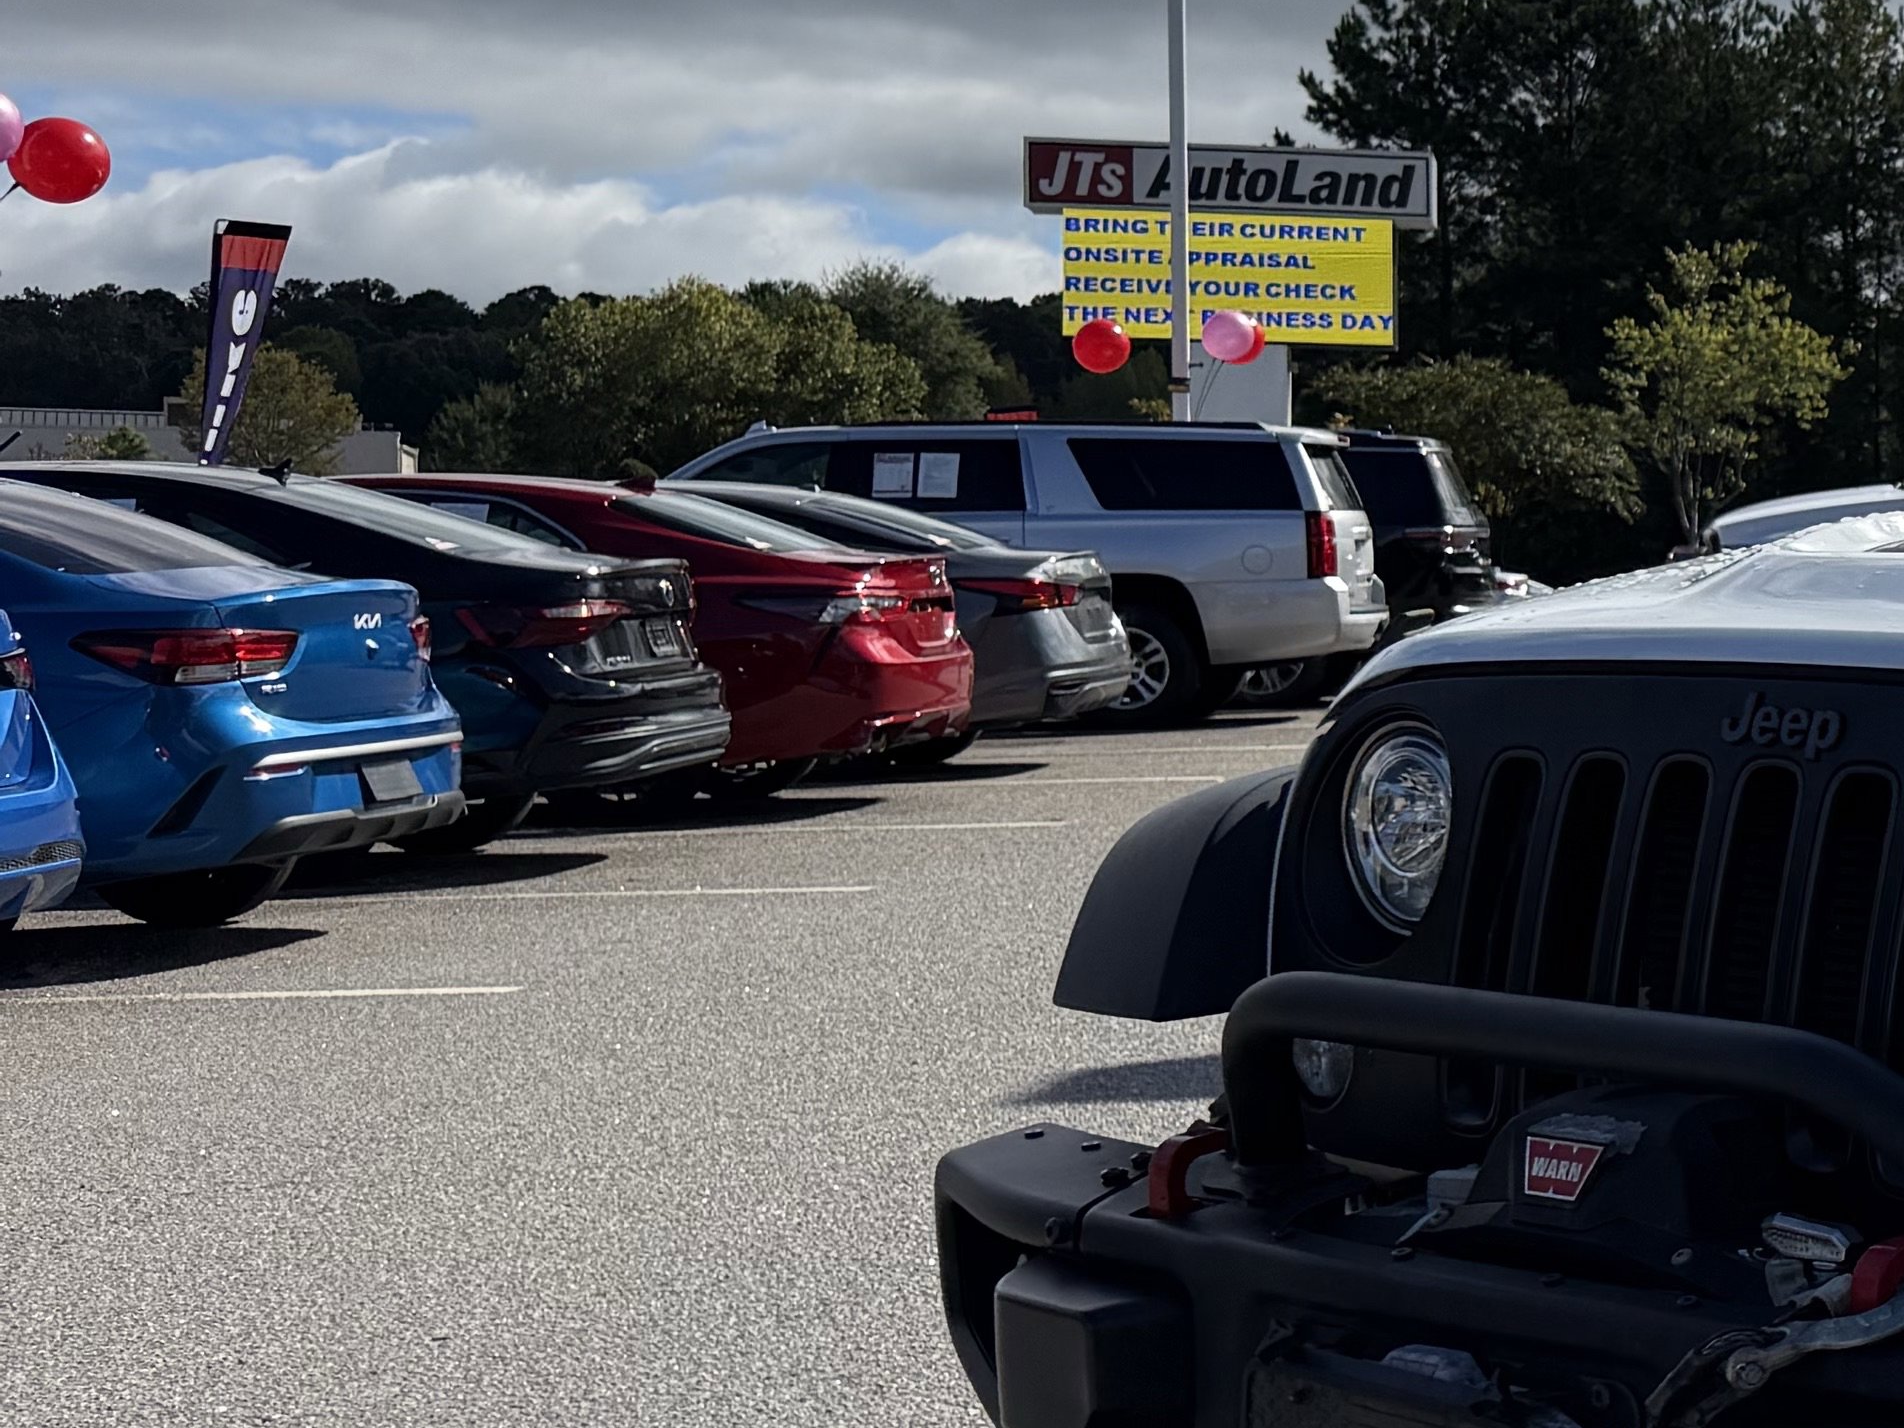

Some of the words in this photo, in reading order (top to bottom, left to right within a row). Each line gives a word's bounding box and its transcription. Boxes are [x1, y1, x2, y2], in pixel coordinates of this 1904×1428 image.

[1065, 217, 1149, 234] BRING
[1155, 220, 1235, 237] TEIR
[1240, 223, 1367, 242] CURRENT
[1064, 246, 1164, 265] ONSITE
[1168, 250, 1316, 270] PPRAISAL
[1189, 280, 1260, 298] YOUR
[1265, 283, 1357, 301] CHECK
[1065, 305, 1118, 323] THE
[1125, 307, 1195, 325] NEX
[1202, 310, 1333, 328] INESS
[1341, 313, 1393, 331] DAY
[1721, 691, 1841, 759] Jeep
[1531, 1157, 1583, 1183] WARN
